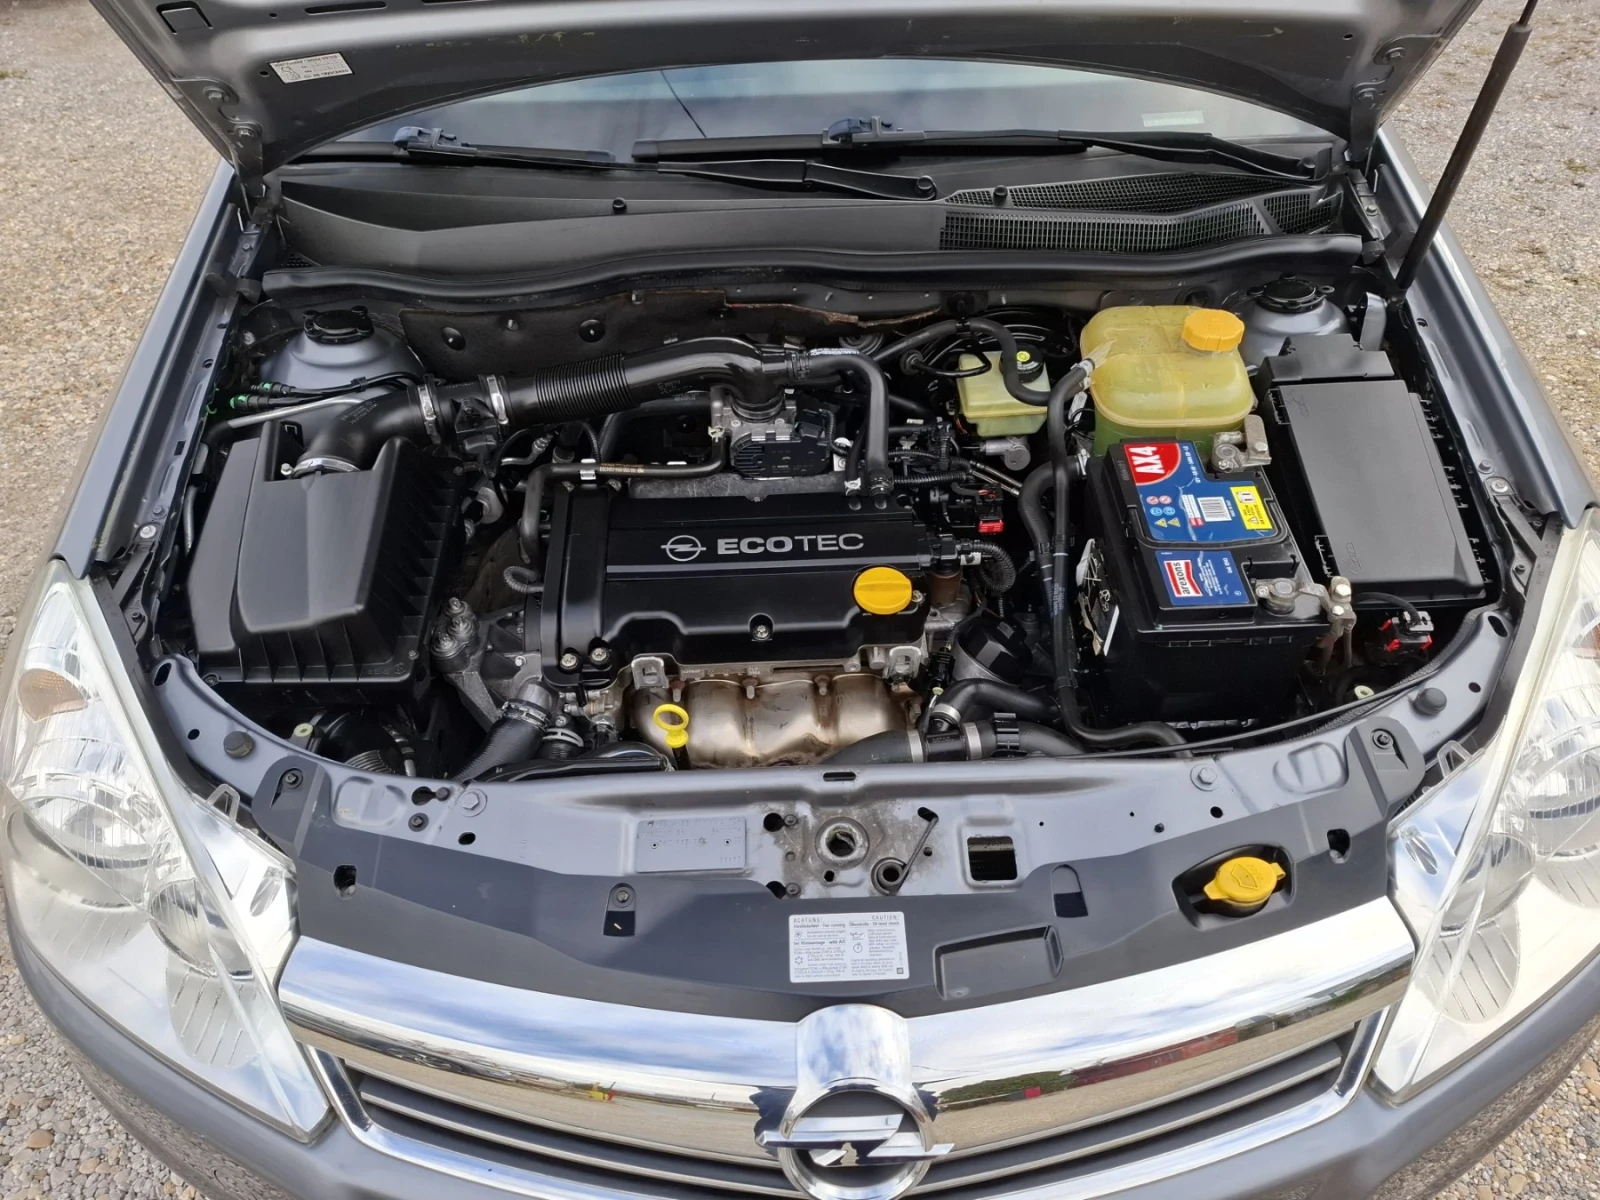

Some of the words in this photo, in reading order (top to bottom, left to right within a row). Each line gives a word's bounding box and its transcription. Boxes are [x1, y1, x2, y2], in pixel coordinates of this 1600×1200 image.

[1129, 445, 1165, 474] AX4
[717, 533, 865, 555] ECOTEC
[1172, 561, 1191, 595] arexons
